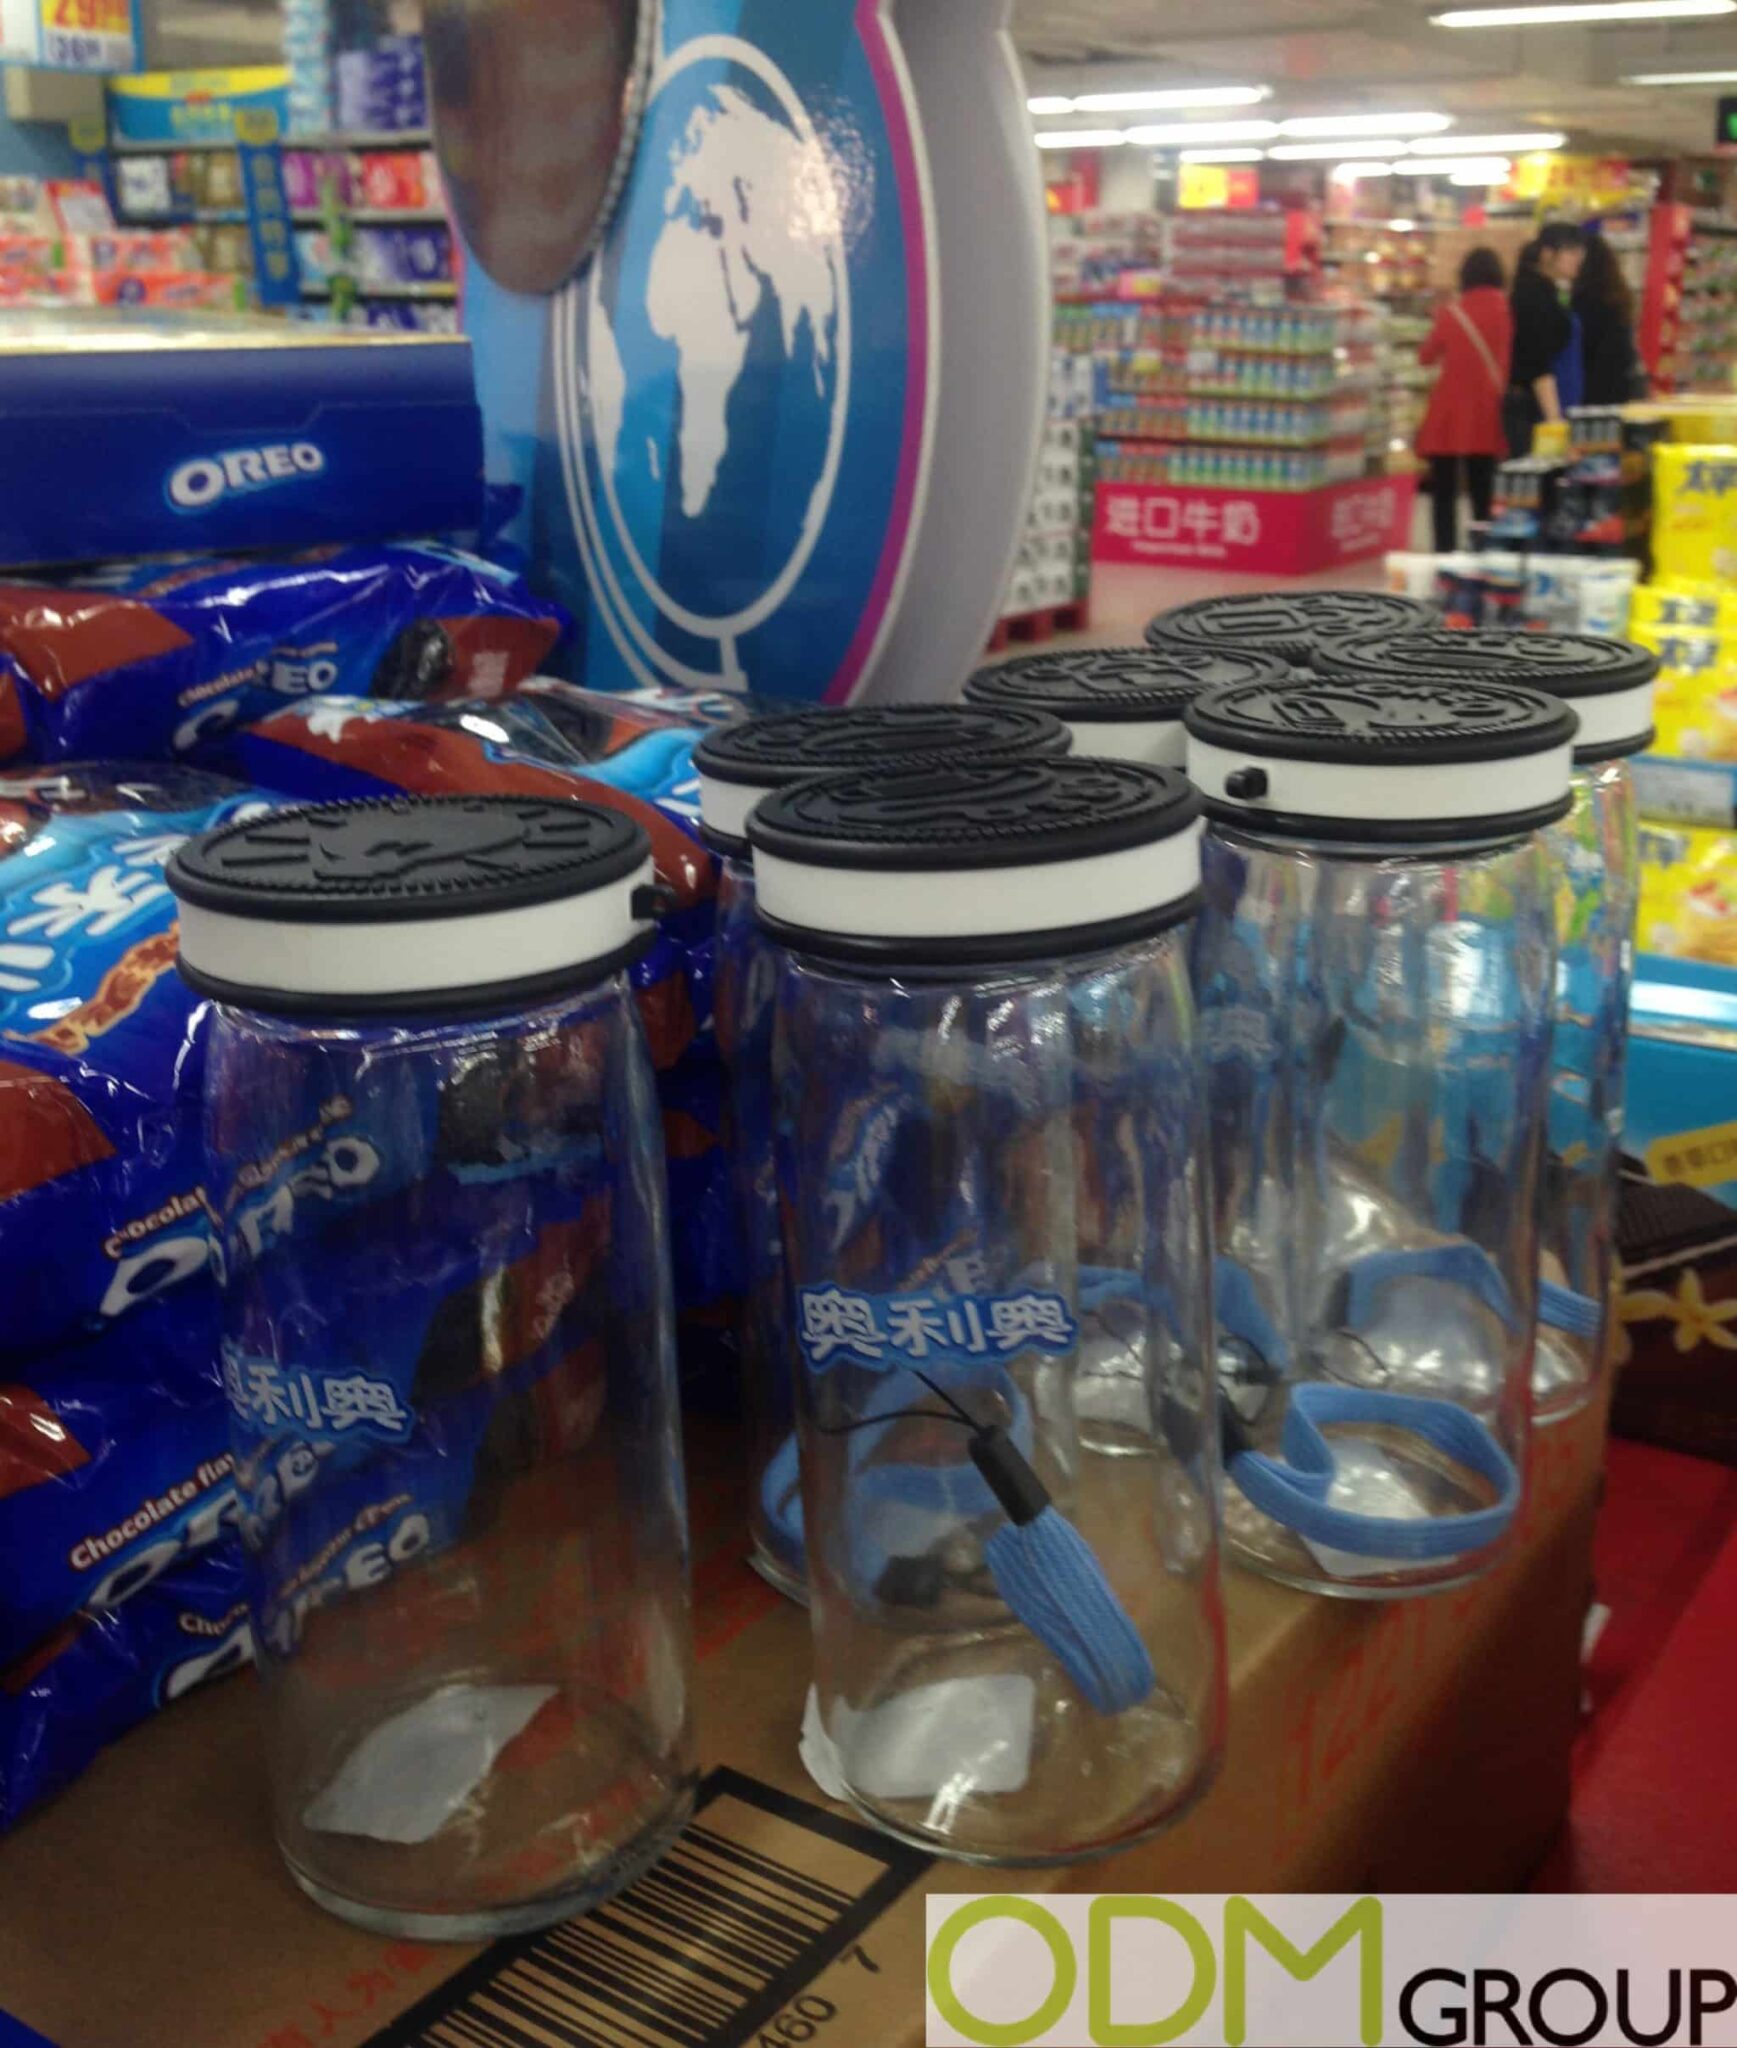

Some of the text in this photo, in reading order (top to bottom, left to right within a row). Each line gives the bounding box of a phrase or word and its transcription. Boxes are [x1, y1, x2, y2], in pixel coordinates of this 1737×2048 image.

[169, 443, 323, 507] OREO
[802, 1289, 1073, 1361] 奥利奥
[69, 1478, 198, 1570] Chocolate
